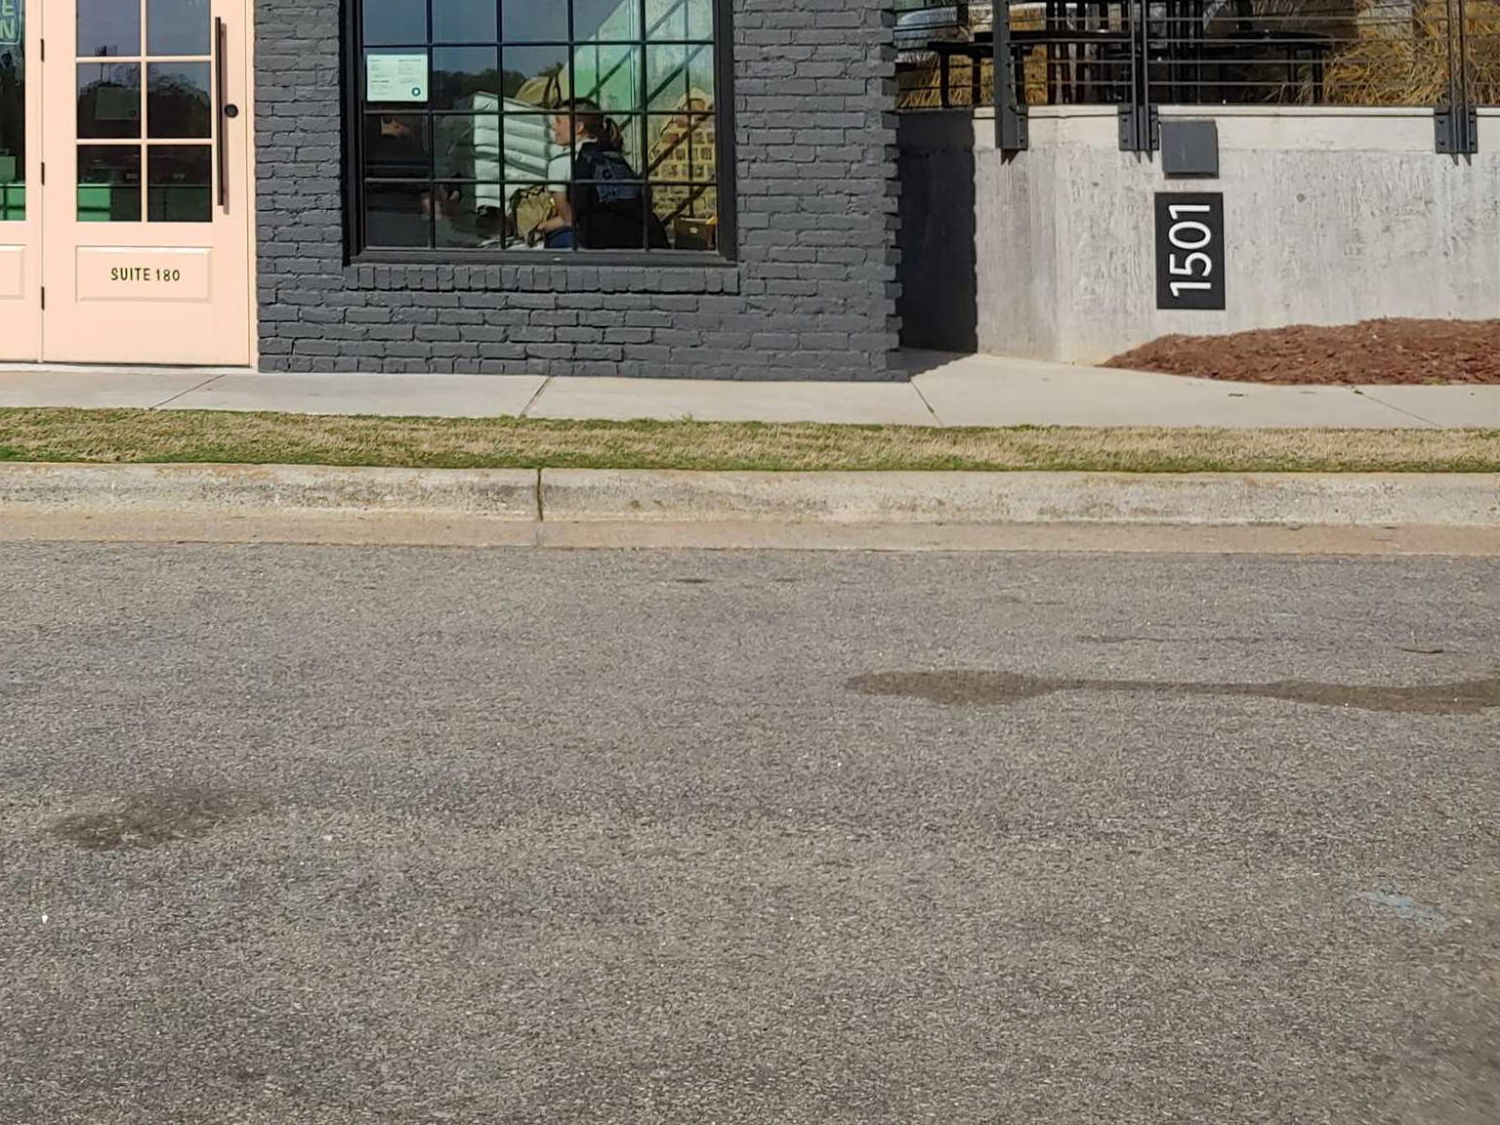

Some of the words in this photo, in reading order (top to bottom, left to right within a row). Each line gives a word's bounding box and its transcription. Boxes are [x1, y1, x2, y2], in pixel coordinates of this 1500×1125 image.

[111, 267, 151, 281] SUITE
[156, 268, 180, 282] 180
[1168, 204, 1212, 297] 1501
